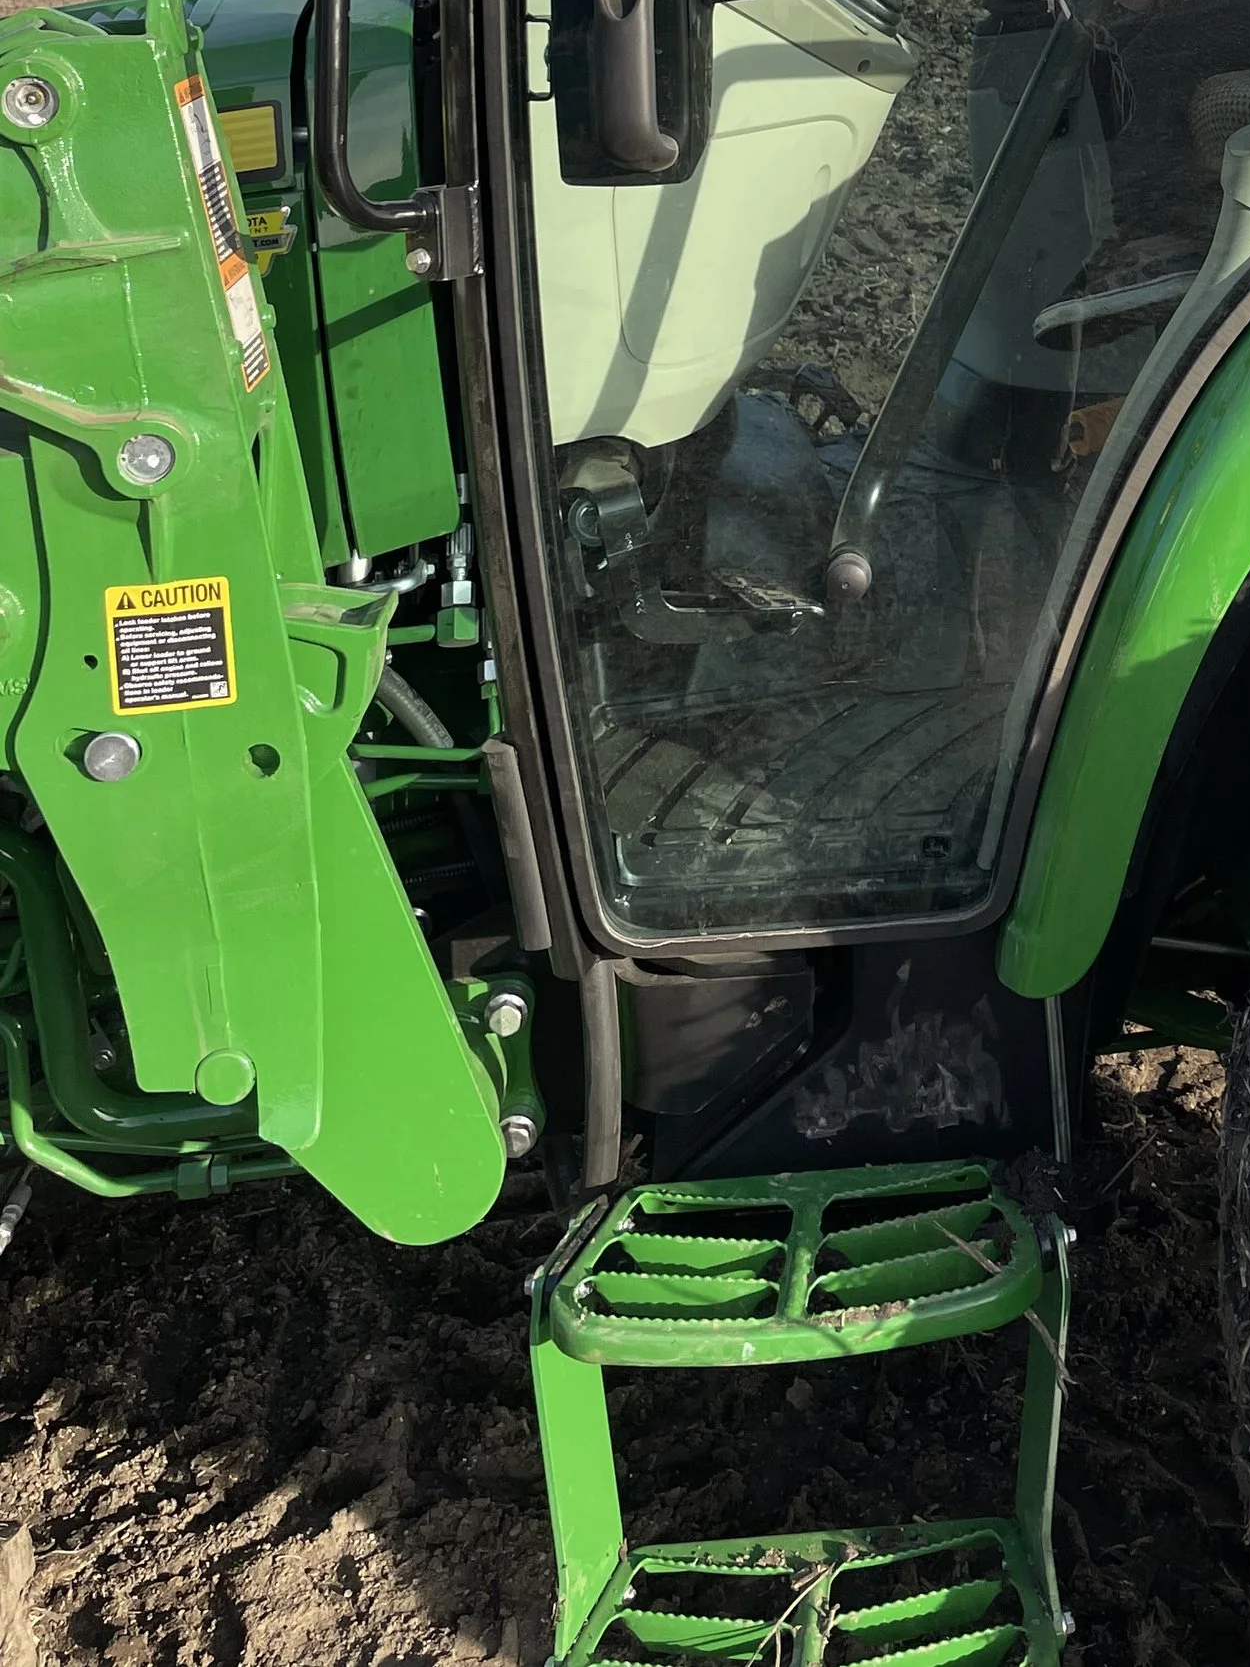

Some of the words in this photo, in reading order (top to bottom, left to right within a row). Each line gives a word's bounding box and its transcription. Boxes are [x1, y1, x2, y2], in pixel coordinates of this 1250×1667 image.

[141, 582, 221, 608] CAUTION
[187, 612, 211, 620] before
[186, 646, 211, 656] ground
